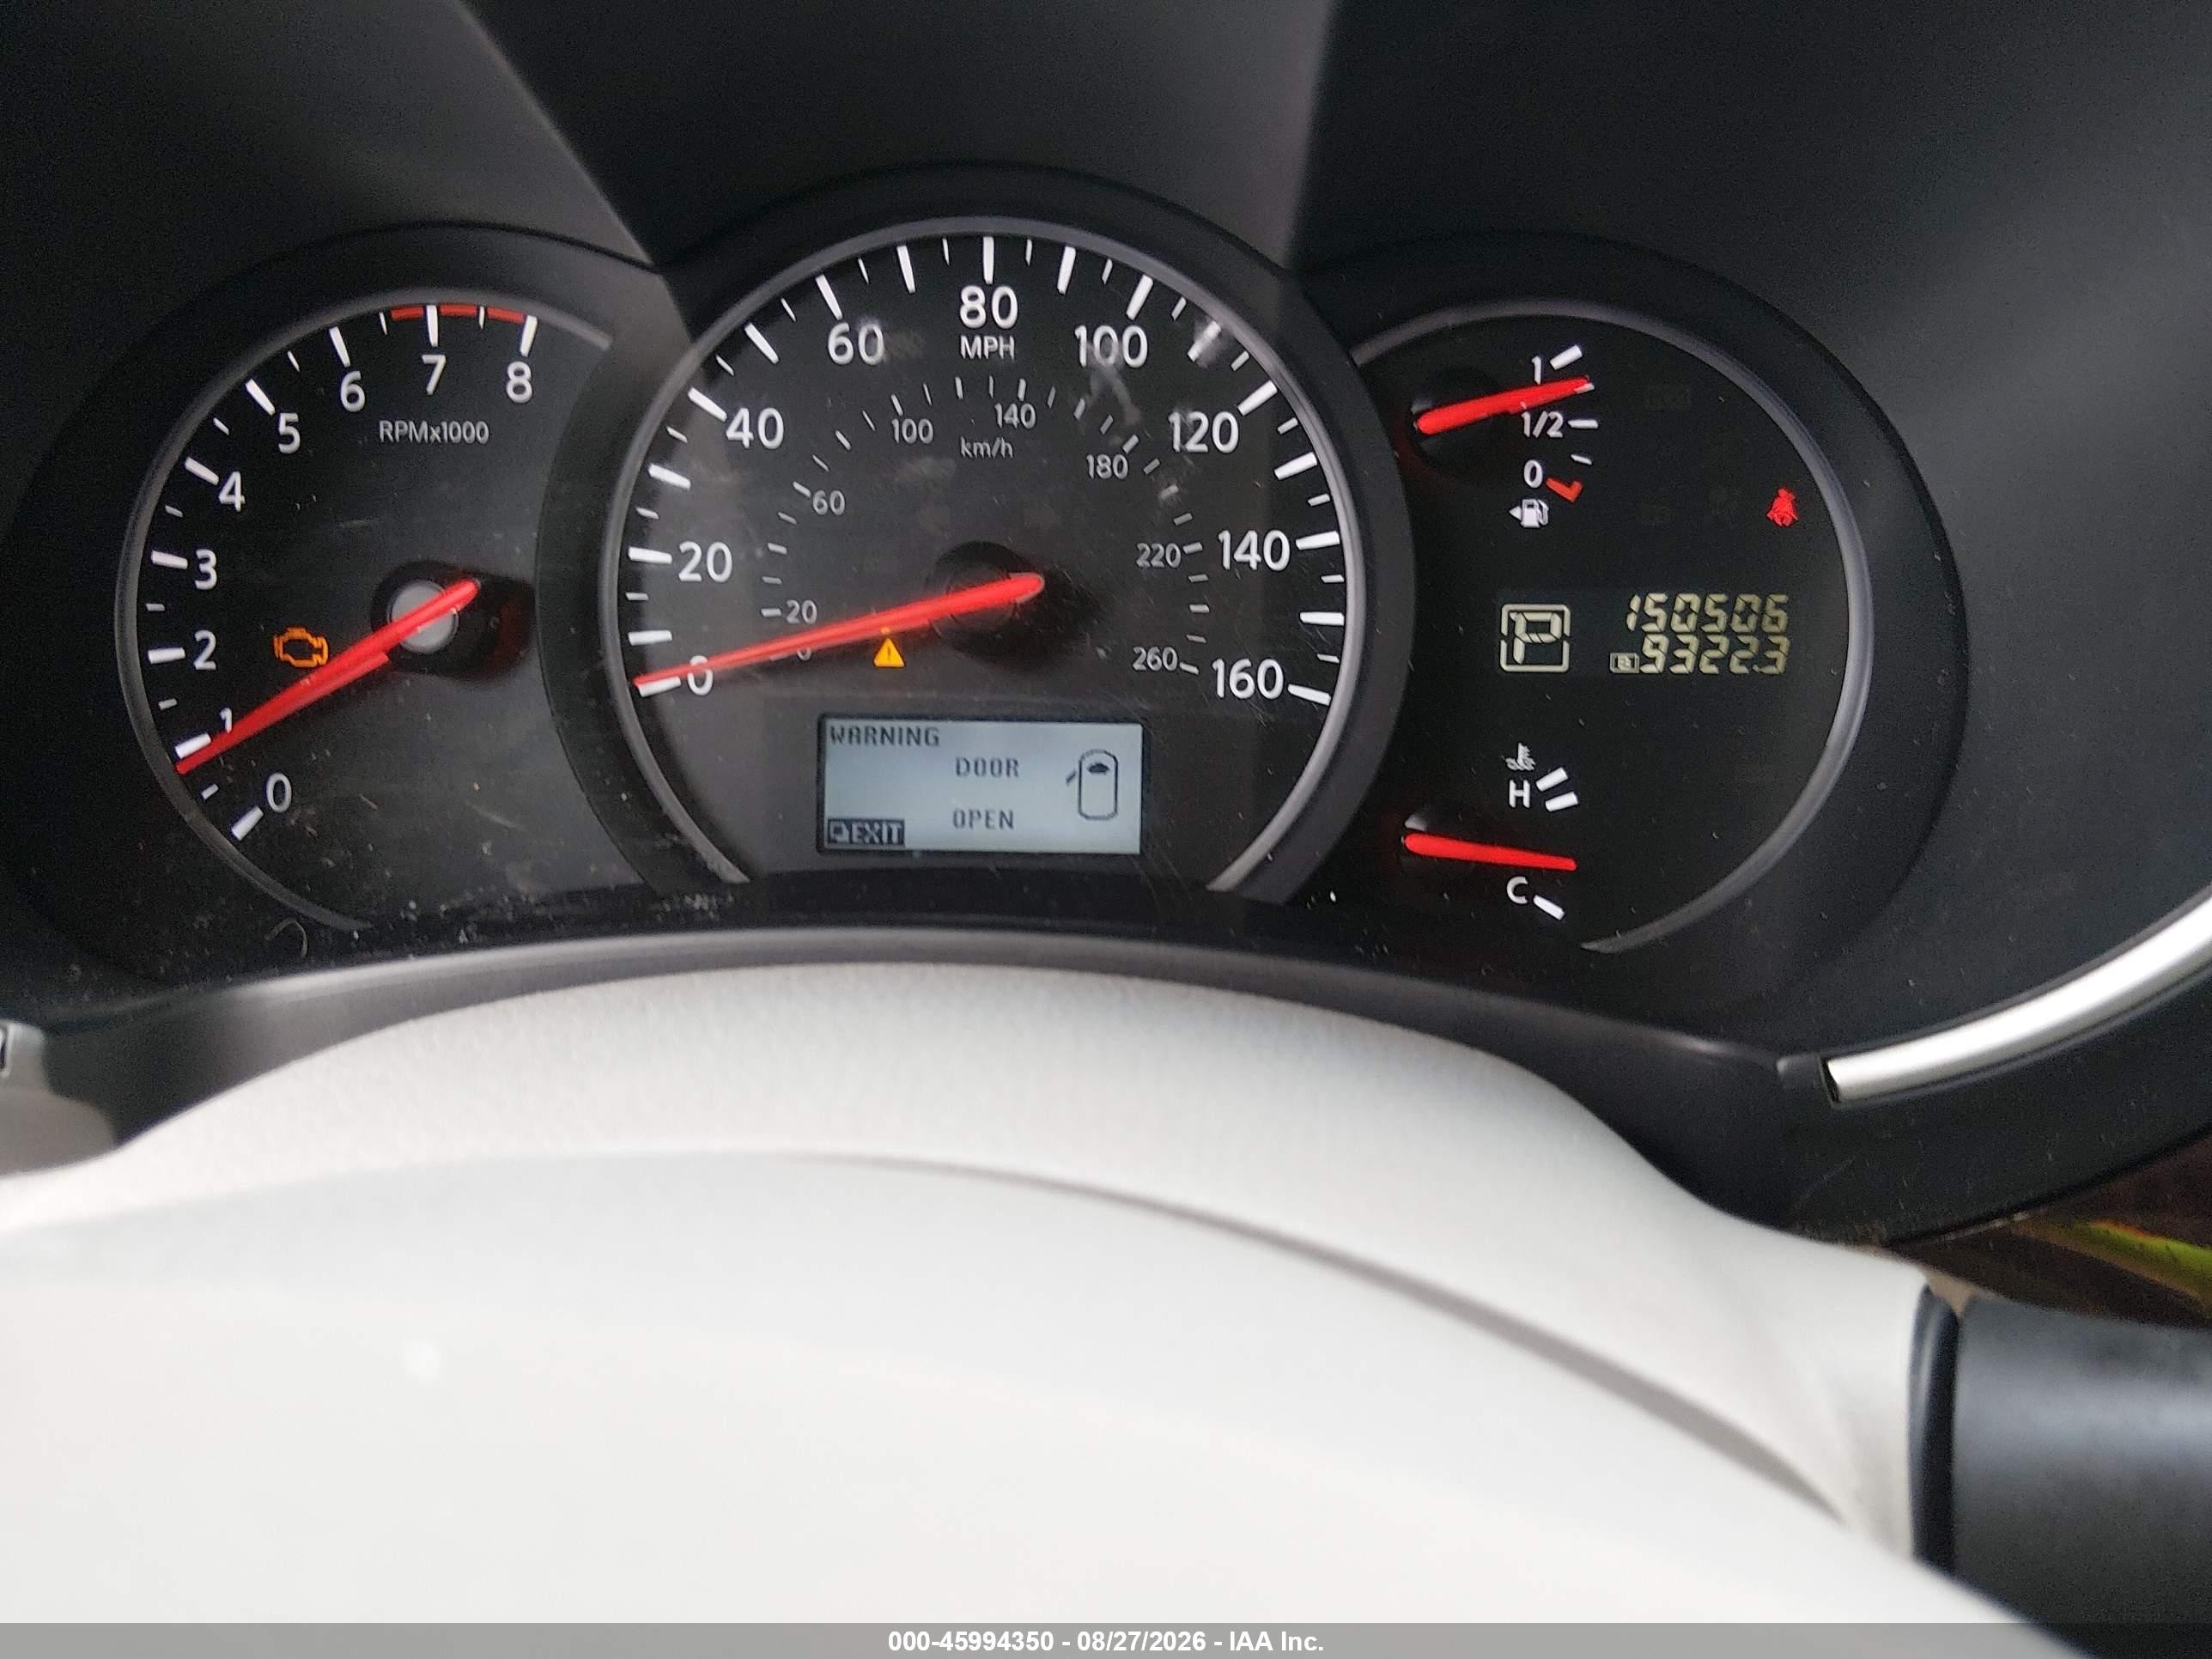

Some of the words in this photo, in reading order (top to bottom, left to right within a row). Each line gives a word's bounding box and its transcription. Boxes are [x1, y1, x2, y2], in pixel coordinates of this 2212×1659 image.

[959, 285, 1018, 330] 80
[827, 322, 884, 365] 60
[960, 335, 1015, 361] MPH
[1074, 325, 1148, 368] 100
[422, 354, 446, 394] 7
[507, 362, 533, 403] 8
[1532, 356, 1542, 385] 1
[339, 371, 366, 412] 6
[725, 407, 785, 449] 40
[994, 402, 1036, 428] 140
[1521, 410, 1564, 438] 1/2
[276, 412, 301, 454] 5
[378, 420, 490, 445] RPMx1000
[891, 418, 934, 444] 100
[1168, 411, 1239, 453] 120
[960, 435, 1015, 459] km/h
[1085, 453, 1129, 479] 180
[1523, 460, 1543, 489] 0
[217, 471, 246, 512] 4
[811, 489, 846, 516] 60
[678, 541, 733, 584] 20
[1135, 543, 1182, 568] 220
[1218, 529, 1291, 572] 140
[193, 549, 218, 590] 3
[786, 599, 817, 625] 20
[1626, 592, 1790, 633] 150506
[193, 630, 217, 672] 2
[1509, 611, 1561, 665] P
[1132, 646, 1179, 672] 260
[1212, 657, 1285, 700] 160
[830, 725, 941, 748] WARNING
[955, 756, 1020, 779] DOOR
[264, 774, 292, 813] 0
[1508, 780, 1531, 808] H
[850, 822, 904, 846] EXIT
[951, 809, 1015, 831] OPEN
[1506, 876, 1528, 905] C
